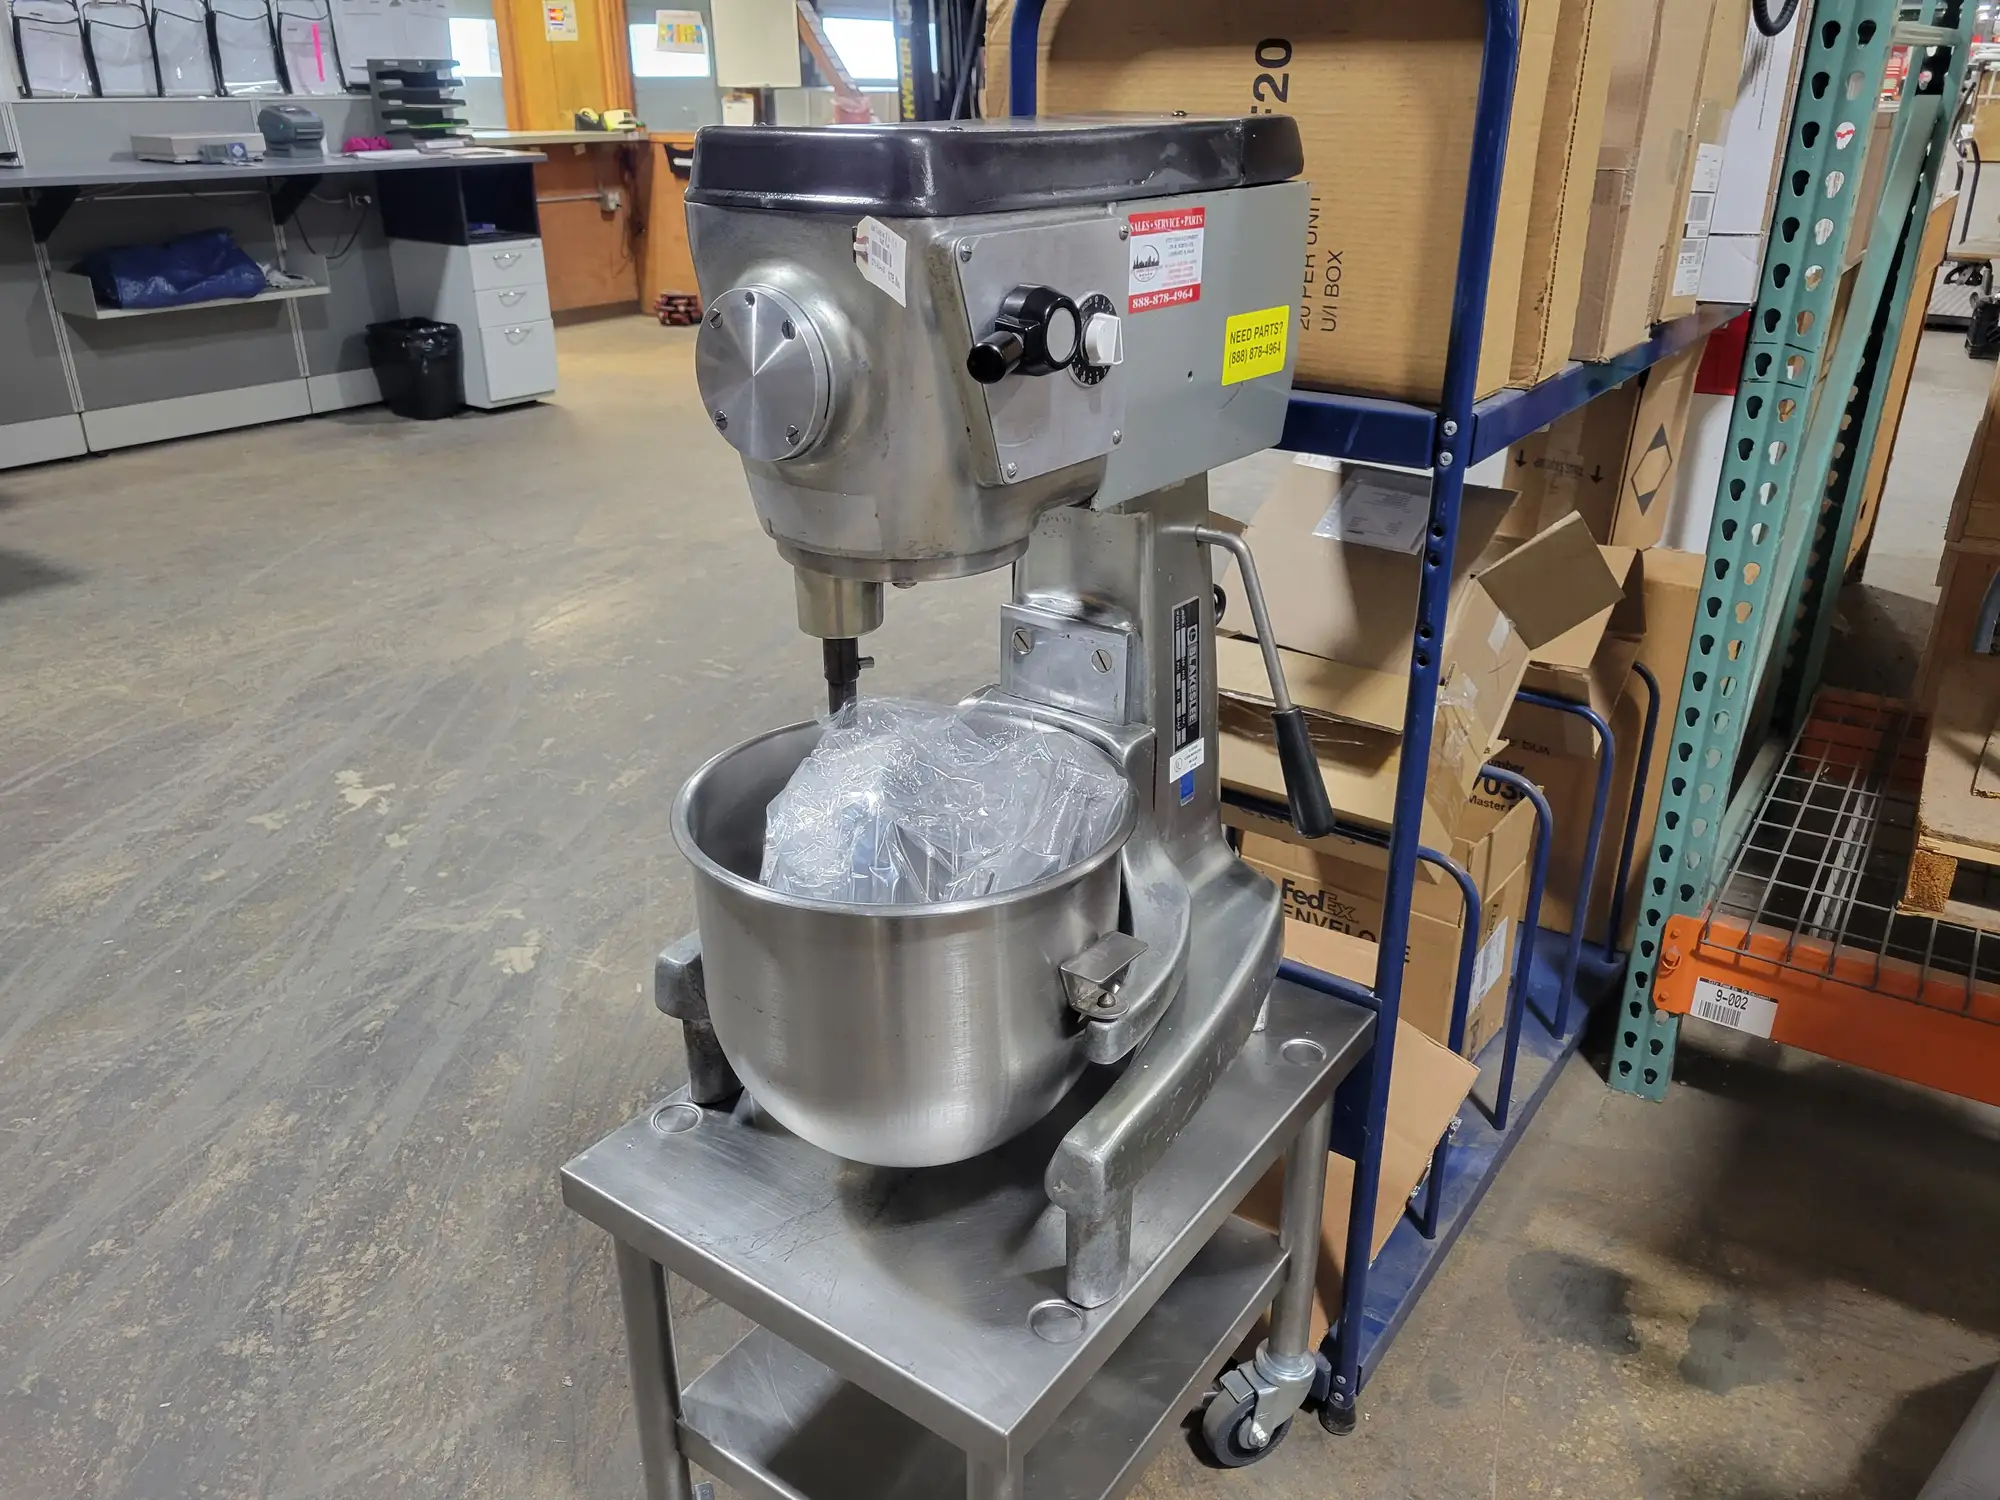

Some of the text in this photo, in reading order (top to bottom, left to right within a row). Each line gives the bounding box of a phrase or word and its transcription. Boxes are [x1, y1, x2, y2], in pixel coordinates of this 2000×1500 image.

[1130, 214, 1203, 232] SALES SERVICE PARTS
[1324, 249, 1343, 298] BOX
[1132, 287, 1193, 309] 888-878-4964
[1229, 321, 1284, 345] NEED PARTS?
[1228, 341, 1281, 369] (888) 878-4964
[1188, 644, 1197, 722] BLAKESLEE
[1469, 795, 1506, 812] Master
[1282, 878, 1357, 923] FedEx
[1715, 989, 1749, 1010] 9-002
